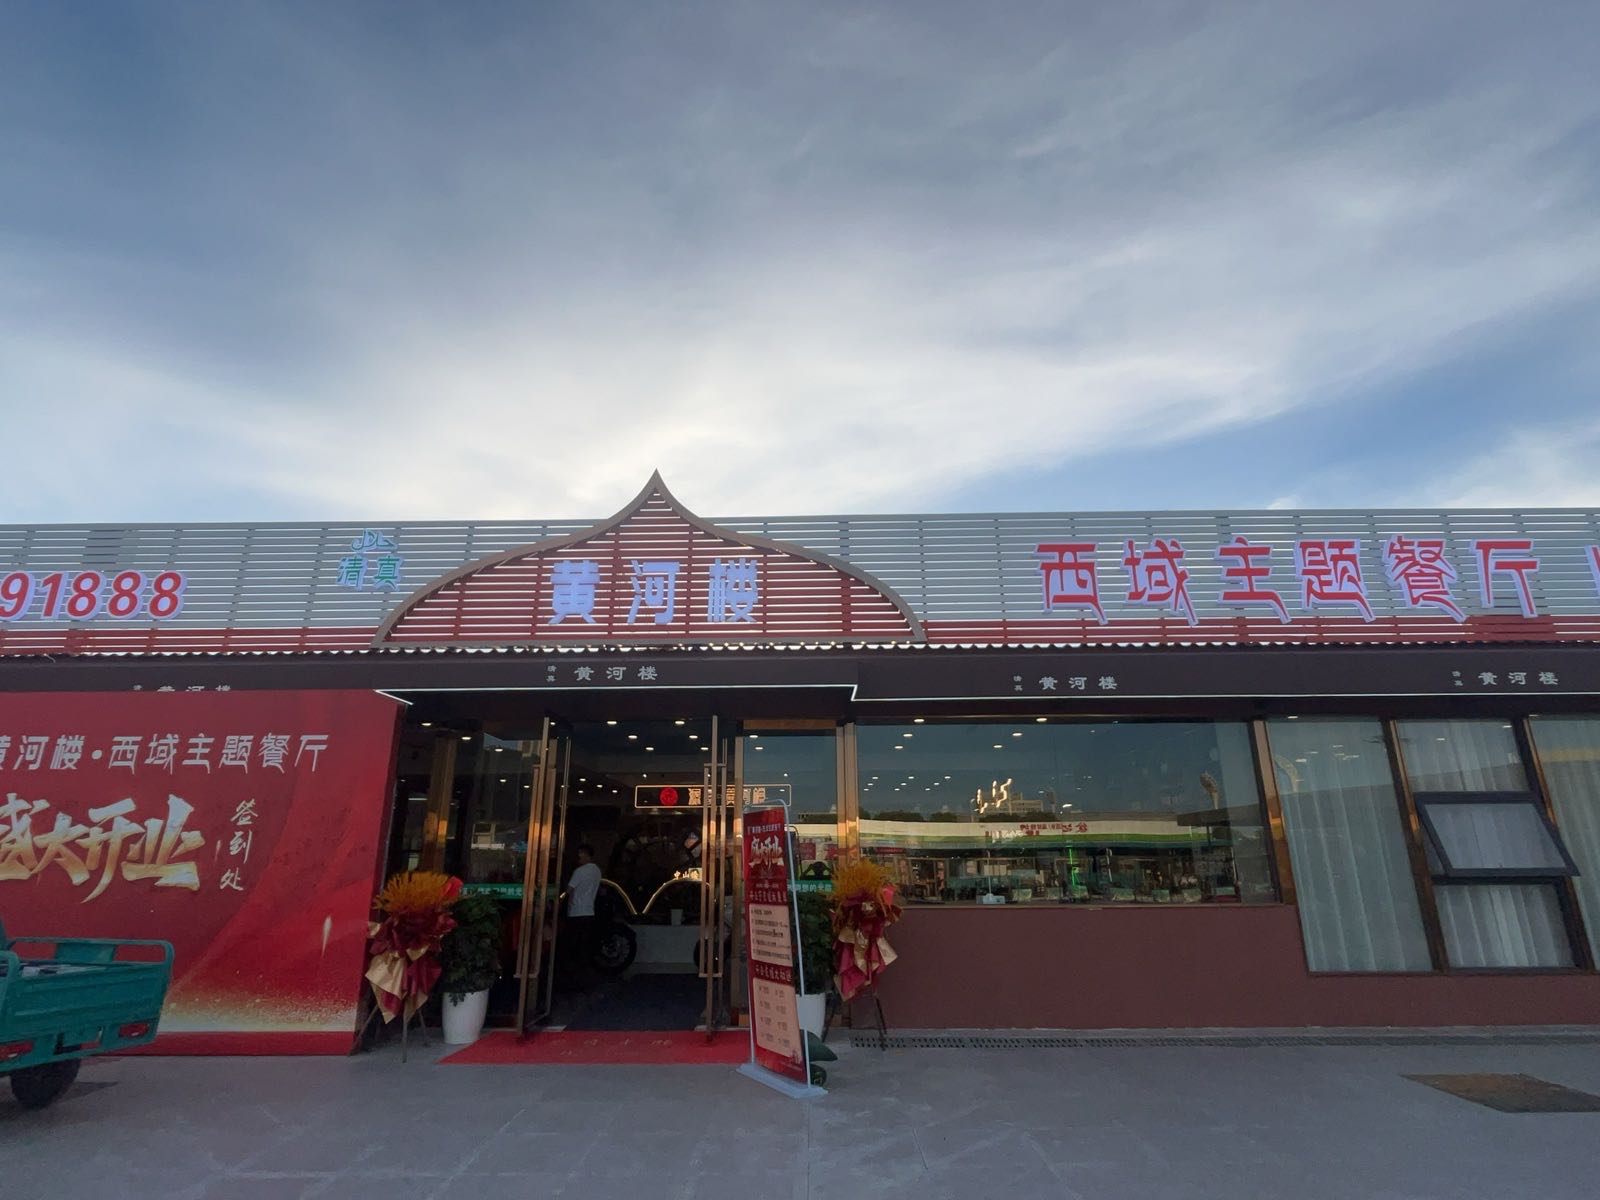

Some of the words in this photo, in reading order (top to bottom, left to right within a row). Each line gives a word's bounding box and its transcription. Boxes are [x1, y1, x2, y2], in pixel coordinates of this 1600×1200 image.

[336, 553, 402, 590] 清真
[548, 557, 758, 625] 黄河楼
[1033, 535, 1539, 626] 西域主题餐厅
[0, 571, 185, 619] 91888
[574, 665, 658, 681] 黄河楼
[1039, 675, 1118, 690] 黄河楼
[1478, 671, 1559, 686] 黄河楼
[219, 798, 259, 892] 签到处
